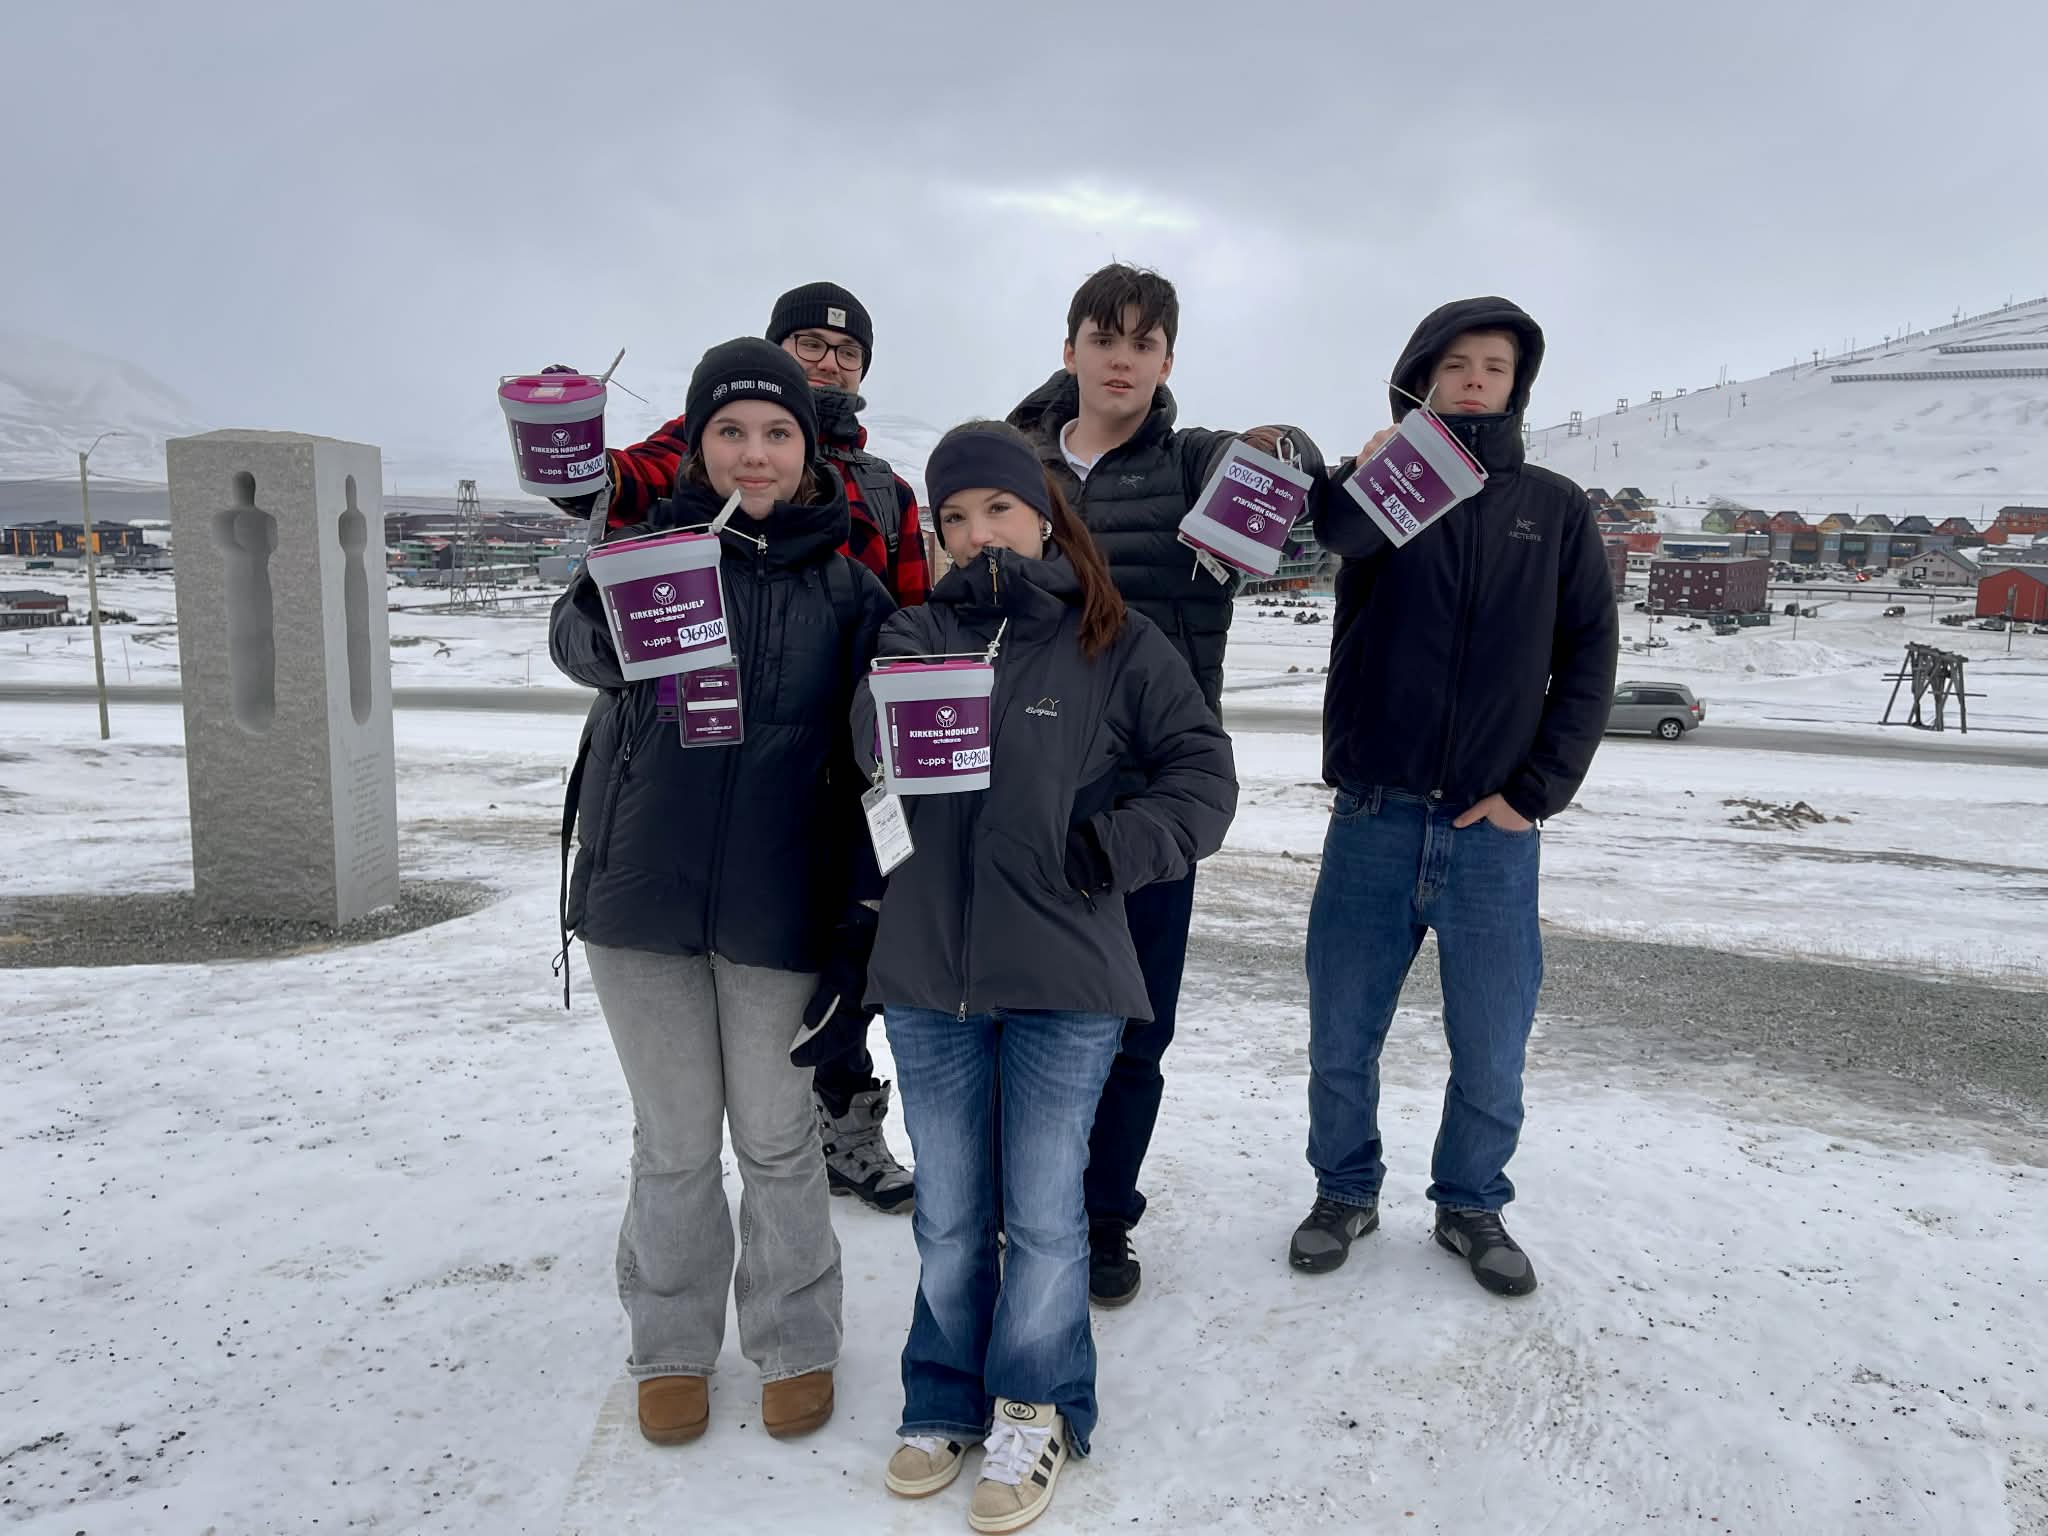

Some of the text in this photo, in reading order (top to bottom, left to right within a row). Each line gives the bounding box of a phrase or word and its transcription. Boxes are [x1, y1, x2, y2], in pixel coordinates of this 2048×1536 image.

[629, 607, 665, 620] KIRKENS
[665, 599, 705, 614] NØDHJELP
[680, 621, 724, 643] 969800
[909, 730, 944, 738] KIRKENS
[944, 726, 979, 737] NØDHJELP
